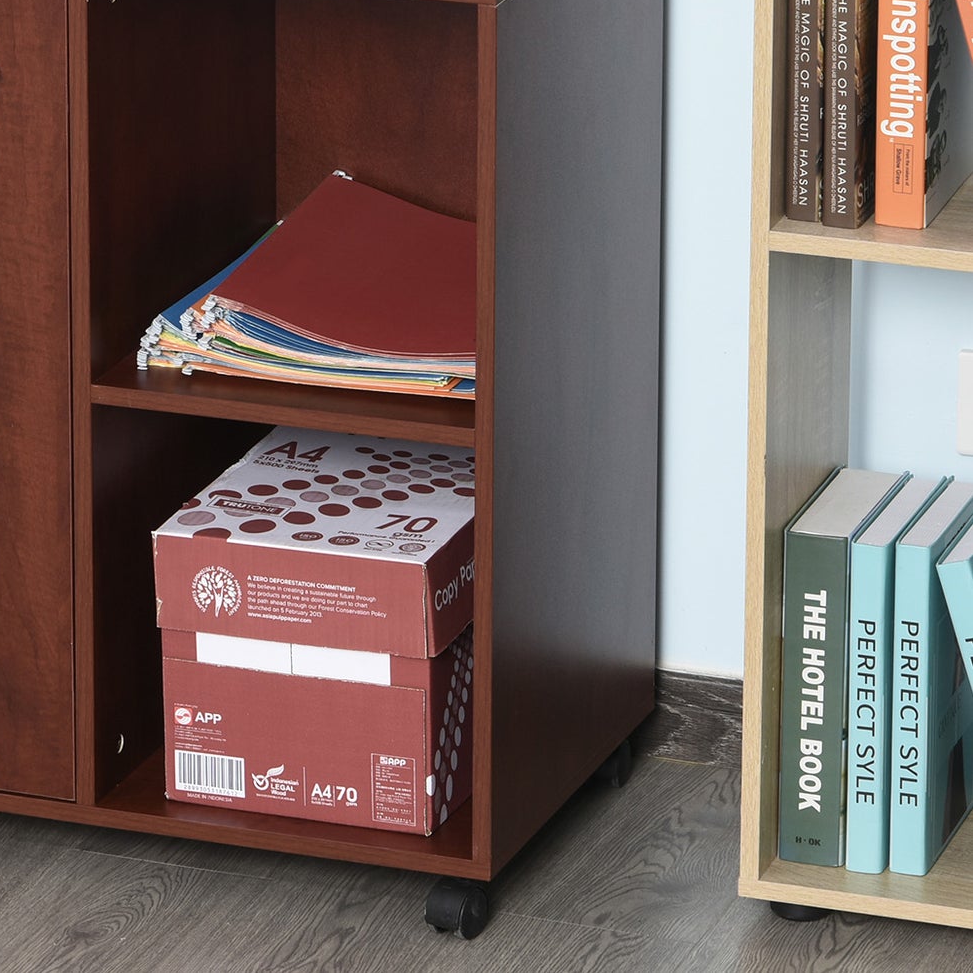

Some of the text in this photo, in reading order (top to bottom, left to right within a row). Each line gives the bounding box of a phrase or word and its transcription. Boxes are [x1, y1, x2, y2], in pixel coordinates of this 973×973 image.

[800, 12, 811, 63] MAGIC
[837, 20, 848, 71] MAGIC
[800, 68, 810, 89] OF
[837, 77, 847, 98] OF
[799, 95, 810, 142] SHRUTI
[837, 103, 847, 151] SHRUTI
[895, 148, 903, 169] Shallow
[798, 149, 809, 206] HAASAN
[836, 157, 847, 215] HAASAN
[257, 454, 276, 462] 210
[283, 459, 319, 469] 297mm
[263, 440, 332, 463] A4
[252, 459, 321, 474] 5x500 Sheets
[222, 500, 279, 514] TRUTONE
[375, 513, 439, 533] 70
[392, 531, 424, 539] gsm
[253, 575, 269, 583] ZERO
[269, 577, 316, 589] DEFORESTATION
[316, 583, 356, 593] COMMITMENT
[257, 583, 276, 591] believe
[283, 586, 304, 595] creating
[309, 589, 339, 598] sustainable
[355, 593, 377, 603] through
[434, 576, 459, 612] Copy
[257, 590, 281, 599] products
[311, 597, 326, 605] doing
[354, 601, 369, 609] chart
[269, 599, 287, 607] ahead
[287, 601, 309, 611] through
[318, 604, 335, 613] Forest
[335, 606, 371, 617] Conservation
[371, 610, 387, 619] Policy
[247, 604, 271, 613] launched
[285, 608, 309, 617] February
[247, 612, 313, 624] www.asiapulppaper.com
[798, 589, 827, 813] THE HOTEL BOOK
[195, 711, 223, 725] APP
[855, 619, 876, 806] PERFECT SYLE
[899, 620, 919, 808] PERFECT SYLE
[388, 757, 407, 767] APP
[271, 777, 299, 786] Indonesian
[271, 783, 296, 793] LEGAL
[311, 783, 332, 799] A4
[335, 786, 358, 803] 70
